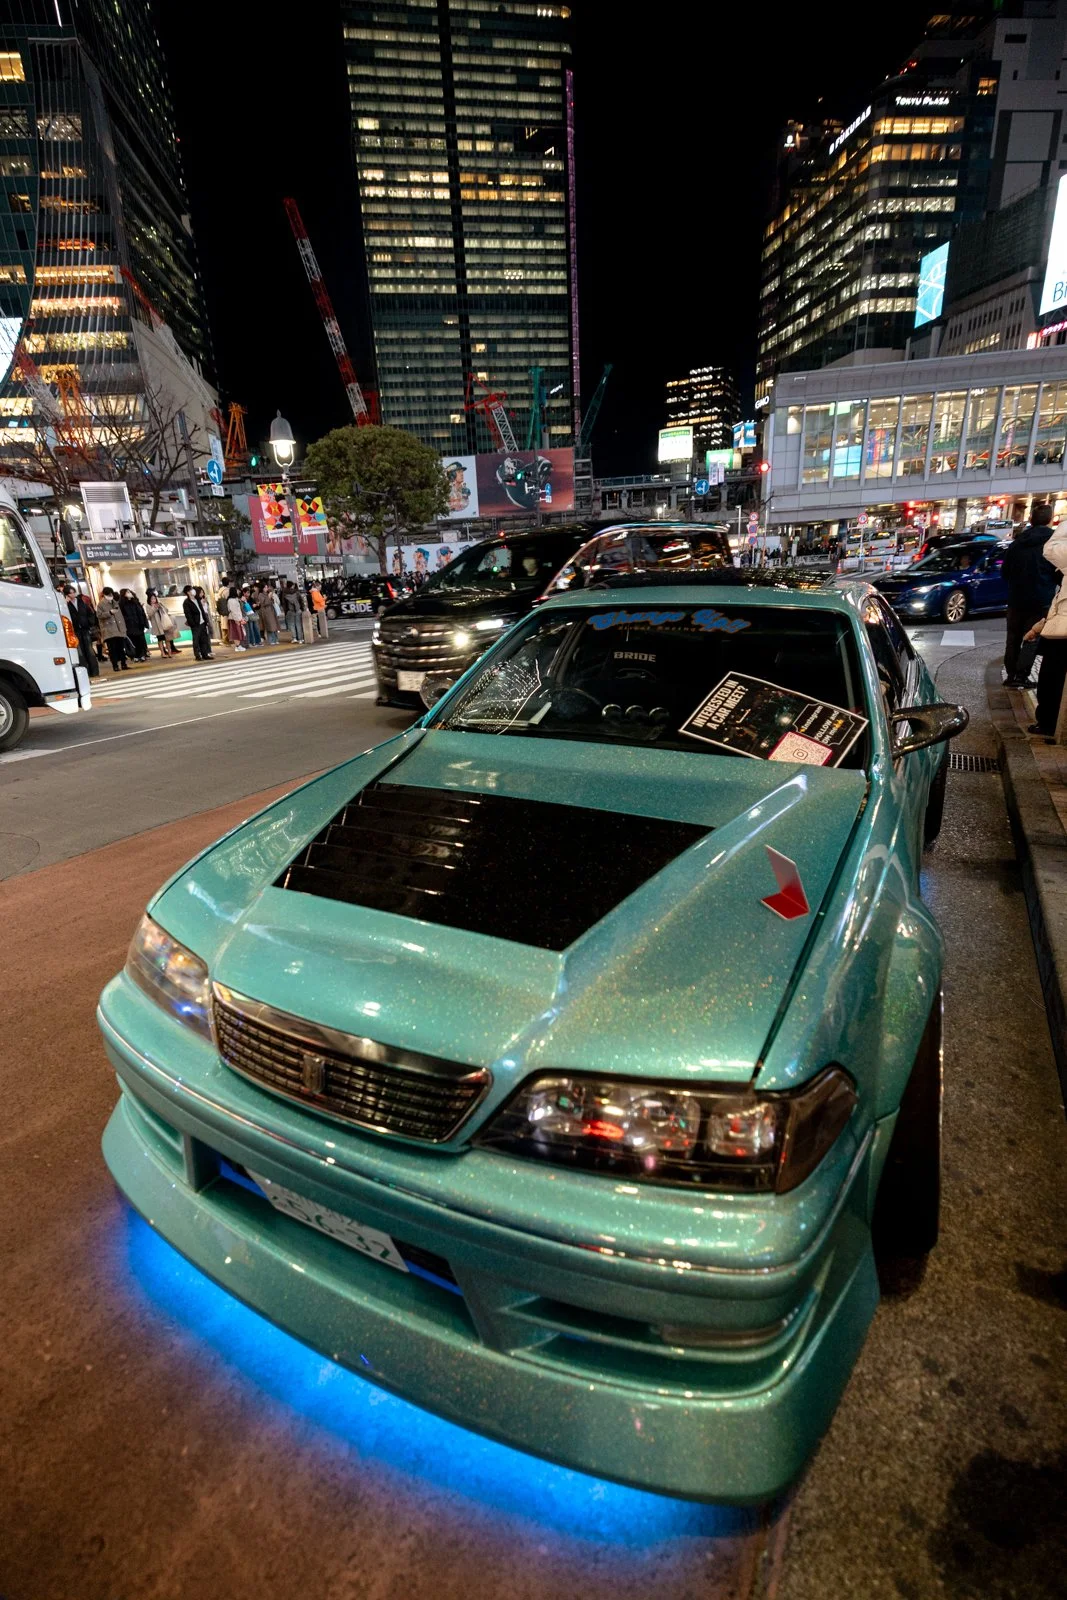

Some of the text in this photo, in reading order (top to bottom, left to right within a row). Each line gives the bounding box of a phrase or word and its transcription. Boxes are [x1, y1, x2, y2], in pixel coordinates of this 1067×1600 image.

[895, 96, 950, 106] TOKYU PLAZA
[613, 651, 657, 663] BRIDE
[691, 679, 739, 728] INTERESTED IN
[706, 685, 748, 730] A CAR MEET?
[802, 705, 823, 730] Instagram
[814, 719, 832, 741] FOLLOW
